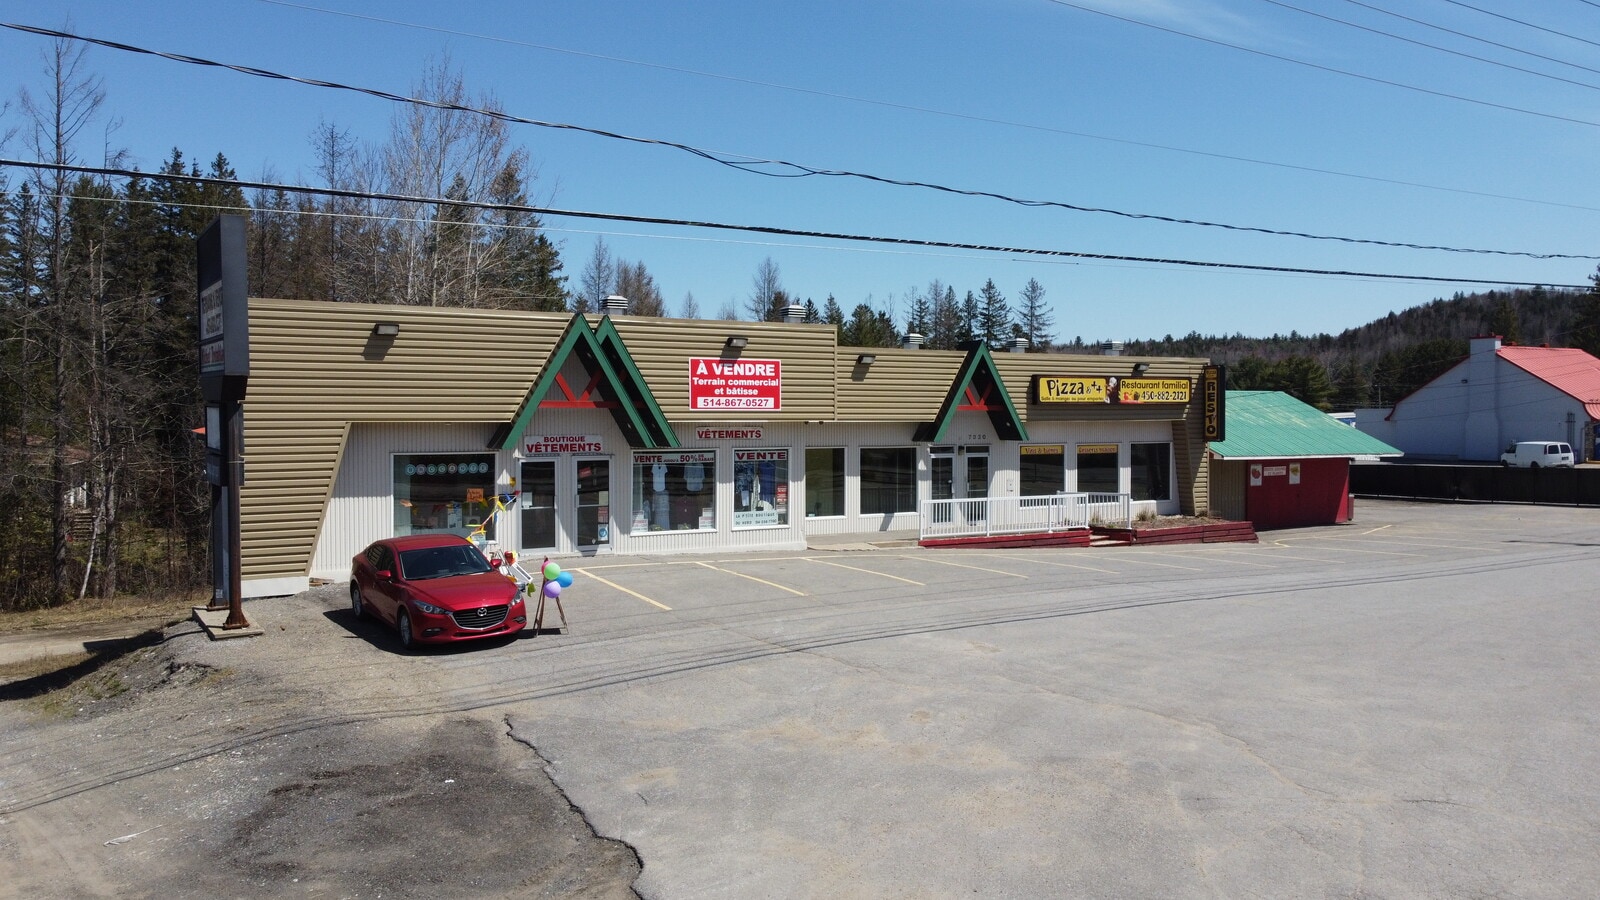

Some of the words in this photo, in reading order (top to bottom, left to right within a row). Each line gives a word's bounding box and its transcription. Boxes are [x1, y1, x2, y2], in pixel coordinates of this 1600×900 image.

[696, 360, 708, 375] À
[712, 362, 775, 376] VENDRE
[692, 377, 726, 386] Terrain
[728, 378, 779, 386] commercial
[1121, 380, 1160, 389] Restaurant
[1162, 381, 1189, 389] familial
[714, 387, 724, 395] et
[726, 387, 759, 395] bâtisse
[1046, 379, 1084, 396] Pizza
[1141, 391, 1187, 400] 450-882-2121
[703, 398, 769, 407] 514-867-0527
[1206, 382, 1216, 434] RESTO
[697, 428, 762, 439] VÊTEMENTS
[526, 442, 602, 453] VÊTEMENTS
[634, 455, 663, 463] VENTE
[736, 452, 786, 460] VENTE
